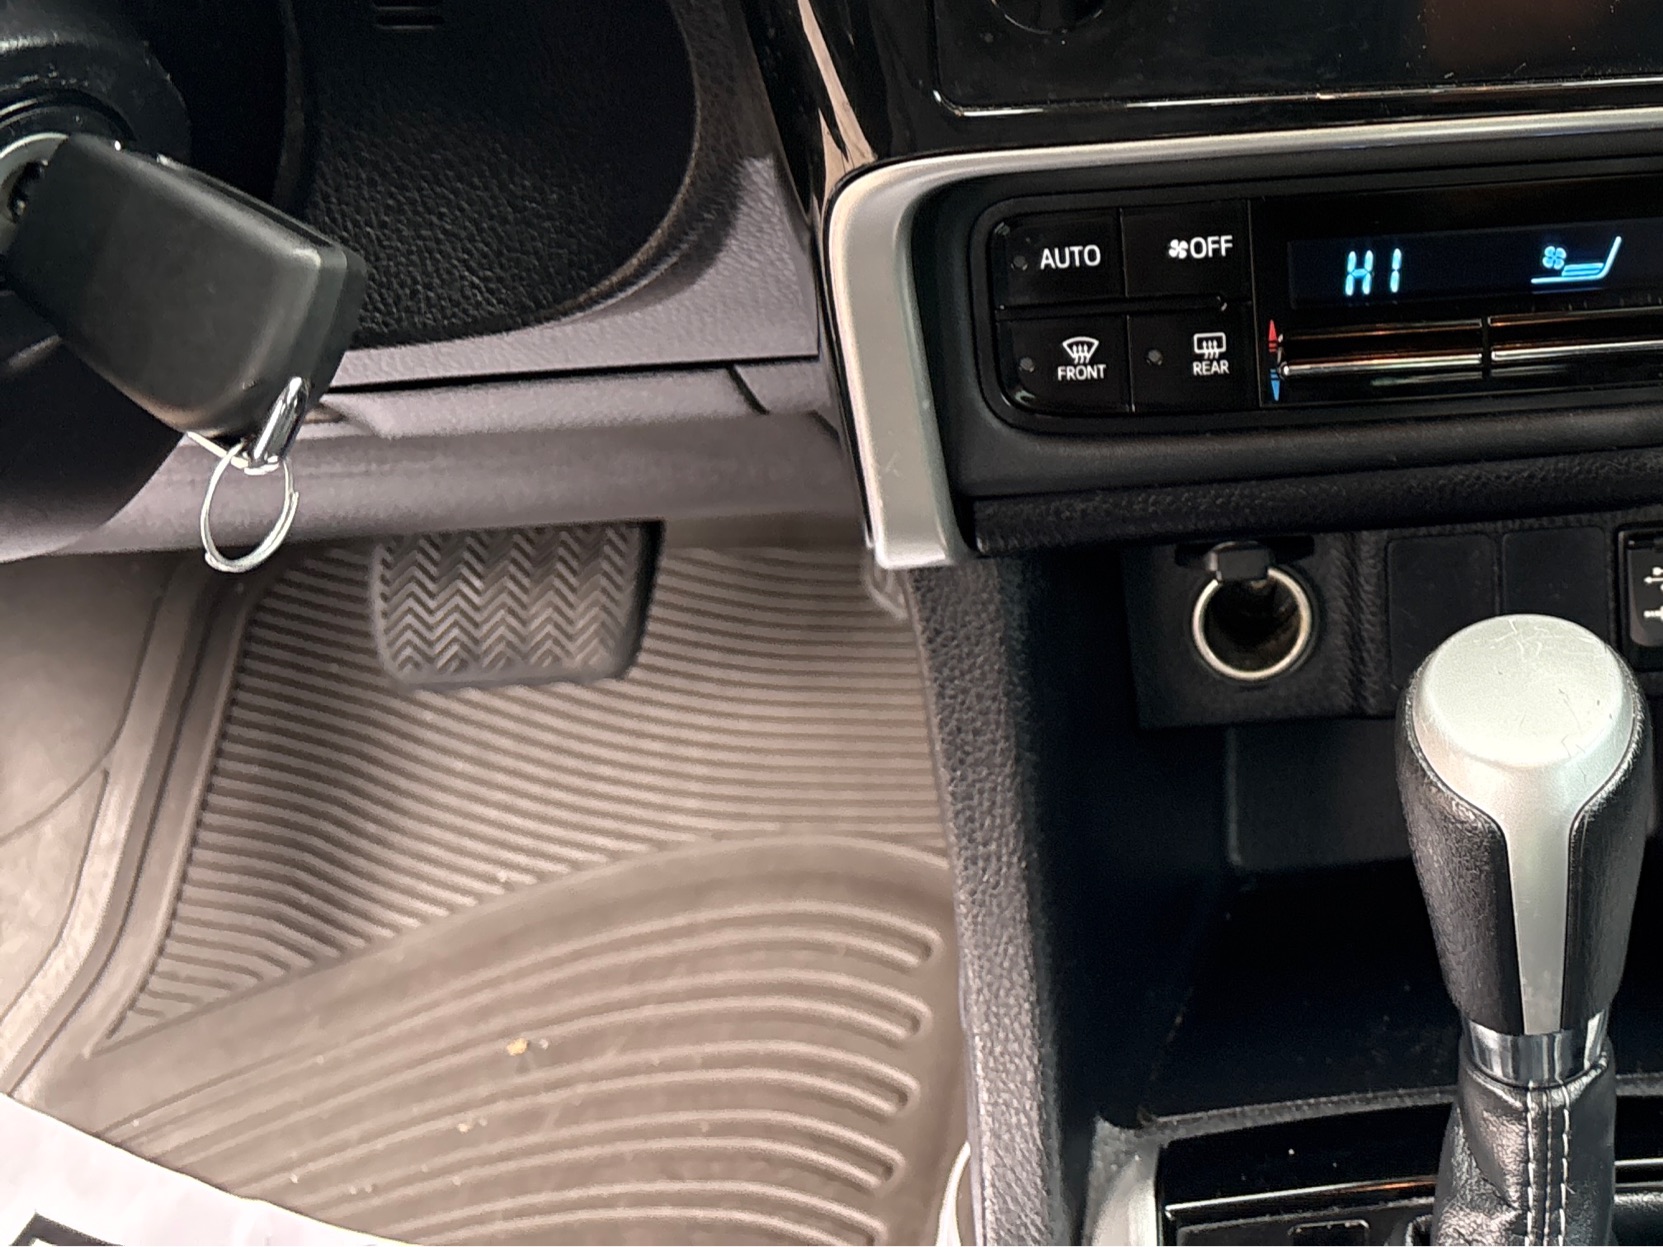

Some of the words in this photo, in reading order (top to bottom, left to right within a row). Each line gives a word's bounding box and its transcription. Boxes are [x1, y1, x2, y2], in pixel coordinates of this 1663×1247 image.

[1039, 245, 1102, 270] AUTO
[1189, 235, 1234, 260] OFF
[1057, 364, 1106, 382] FRONT
[1192, 360, 1231, 376] REAR
